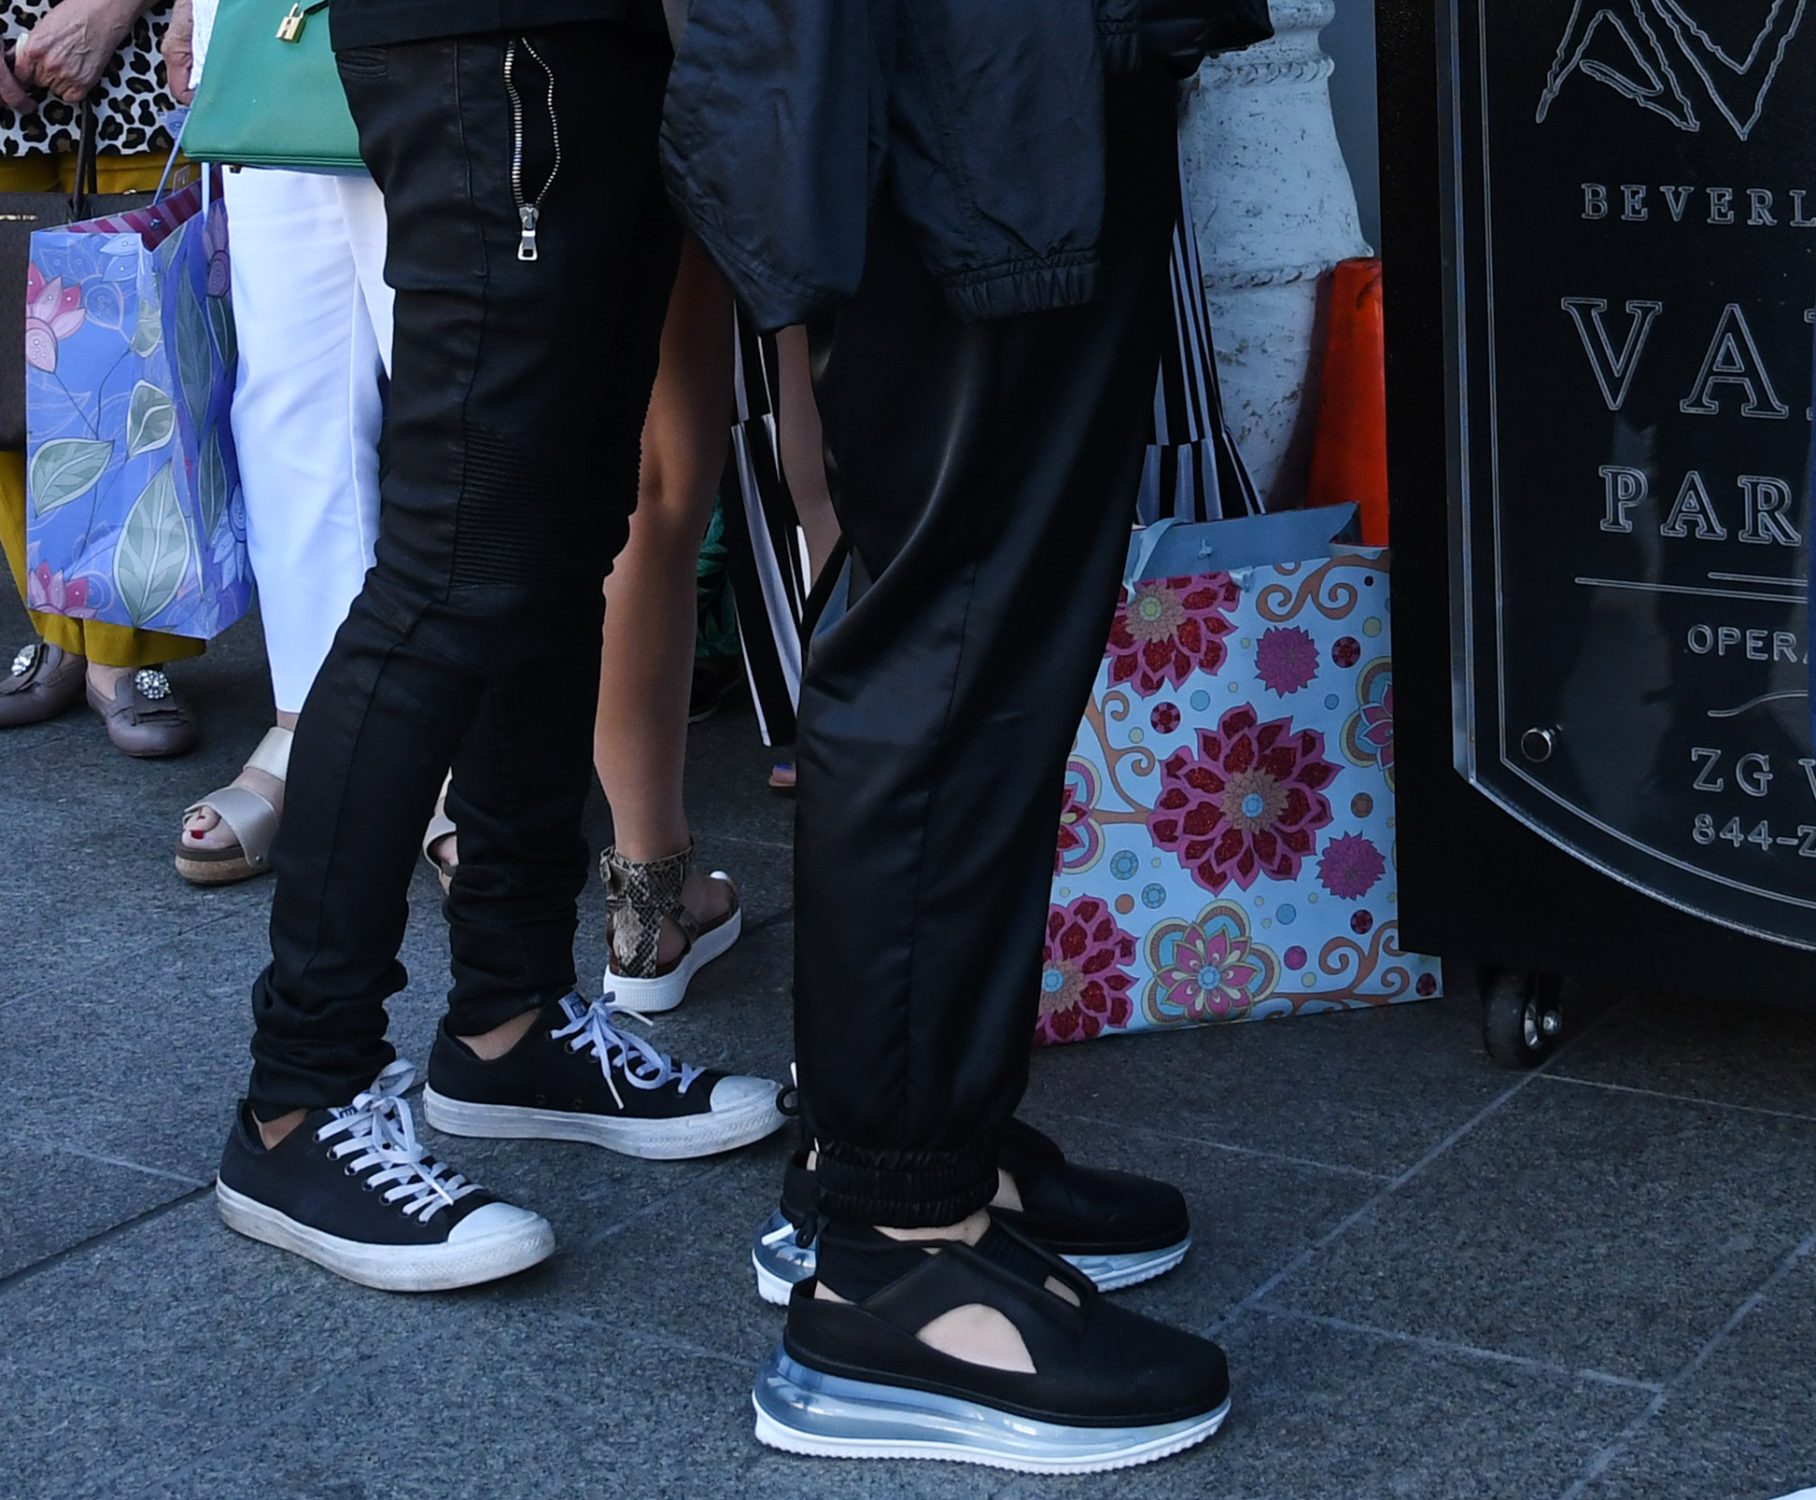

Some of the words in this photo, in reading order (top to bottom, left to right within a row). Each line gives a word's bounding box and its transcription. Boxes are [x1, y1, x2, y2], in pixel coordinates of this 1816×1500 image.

[1560, 296, 1816, 420] VA
[1687, 623, 1808, 665] OPER
[1691, 747, 1774, 798] ZG
